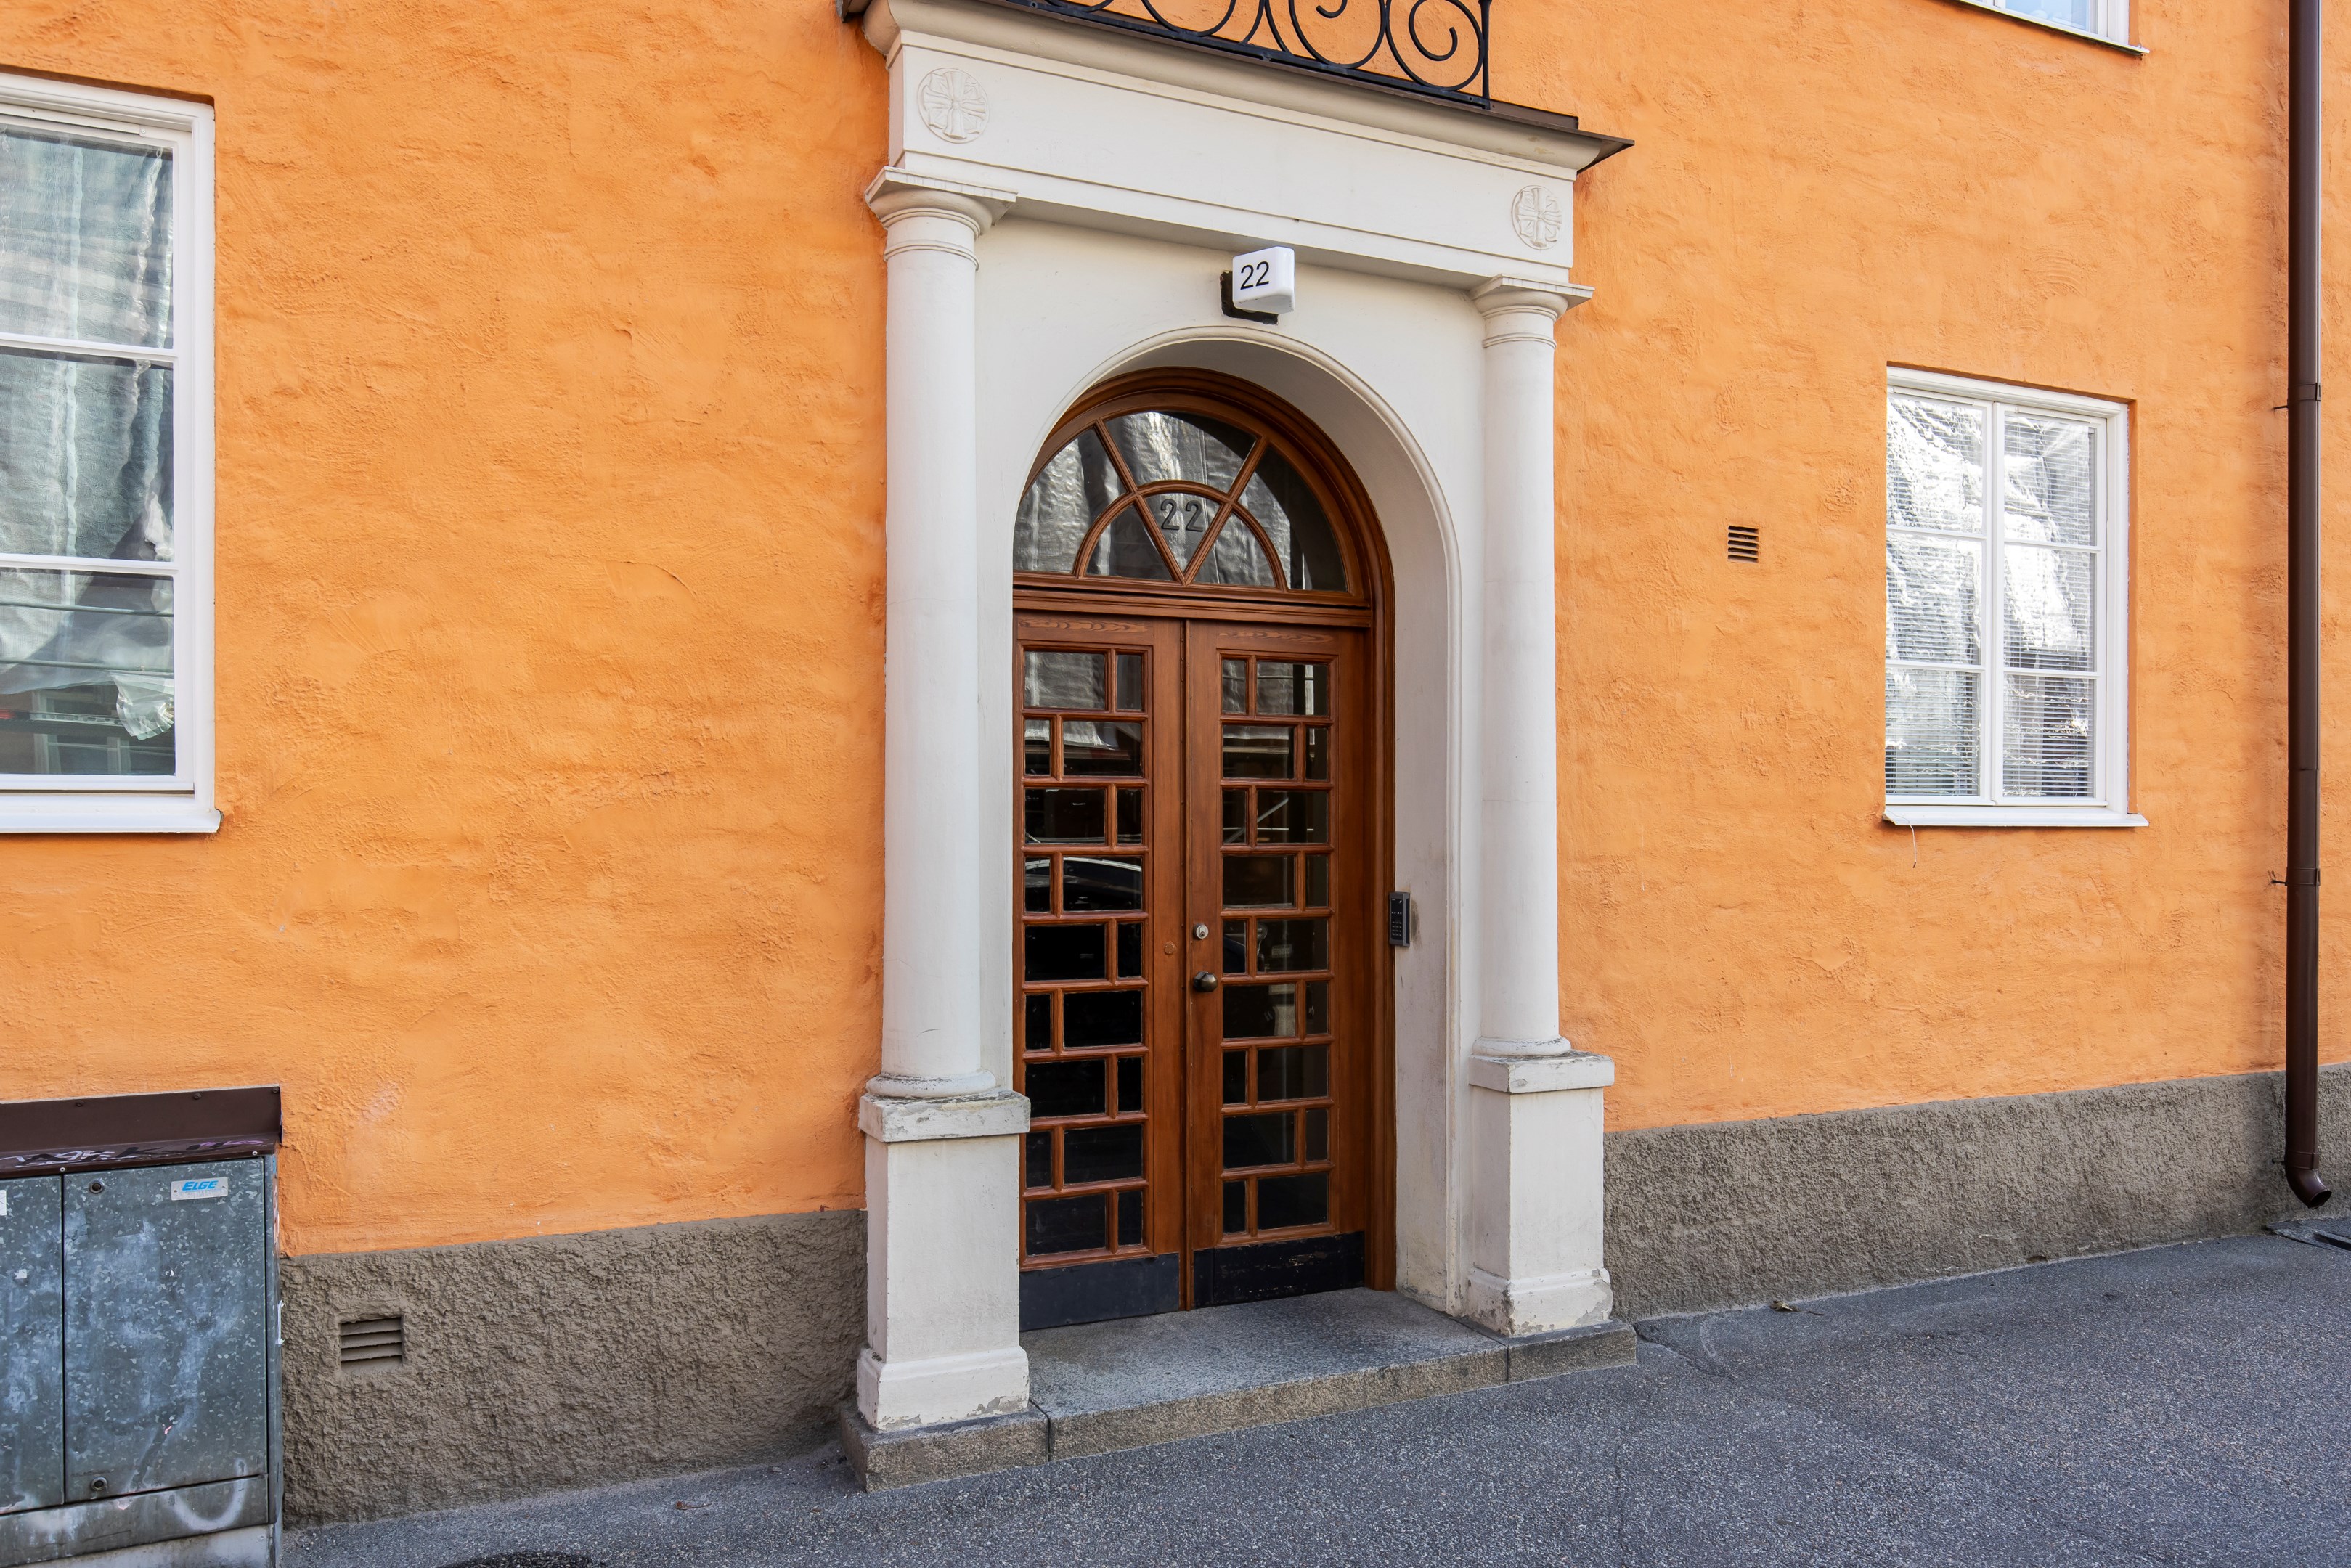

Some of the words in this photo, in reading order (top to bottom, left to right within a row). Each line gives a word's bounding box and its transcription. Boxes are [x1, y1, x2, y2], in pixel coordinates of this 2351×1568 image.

[1240, 261, 1269, 290] 22
[1161, 499, 1203, 532] 22
[182, 1180, 219, 1191] ELGE
